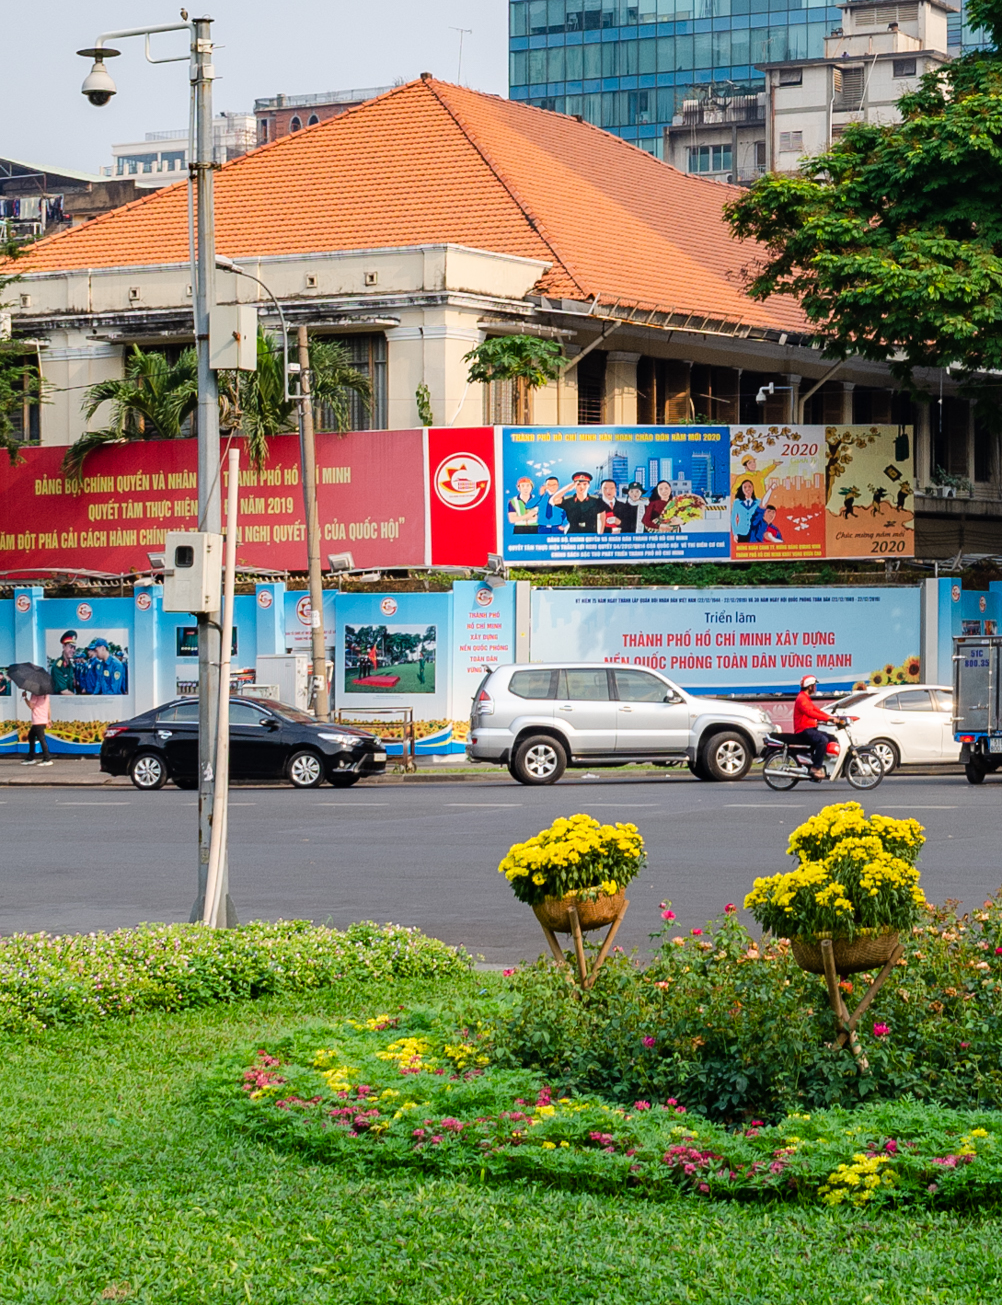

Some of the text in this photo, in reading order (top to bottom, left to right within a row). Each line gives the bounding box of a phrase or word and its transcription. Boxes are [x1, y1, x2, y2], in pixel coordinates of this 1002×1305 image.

[703, 433, 721, 442] 2020
[781, 444, 818, 456] 2020
[35, 474, 62, 495] ĐẢNG
[83, 473, 115, 493] CHÍNH
[117, 470, 150, 493] QUYỀN
[152, 471, 166, 491] VÀ
[168, 469, 197, 490] NHÂN
[261, 464, 281, 486] PHỐ
[284, 463, 298, 486] HỒ
[322, 467, 351, 484] MINH
[88, 498, 119, 522] QUYẾT
[121, 499, 143, 520] TÂM
[146, 500, 172, 521] THỰC
[174, 497, 198, 520] HIỆN
[240, 495, 265, 514] NĂM
[268, 497, 294, 514] 2019
[18, 530, 36, 553] ĐỘT
[38, 529, 58, 549] PHÁ
[61, 527, 78, 549] CẢI
[80, 528, 107, 548] CÁCH
[109, 527, 137, 547] HÀNH
[139, 528, 171, 546] CHÍN
[245, 525, 270, 545] NGHỊ
[273, 519, 306, 543] QUYẾT
[324, 519, 346, 540] CỦA
[349, 517, 378, 540] QUỐC
[870, 540, 906, 553] 2020
[704, 610, 756, 624] Triển lãm
[622, 628, 836, 648] THÀNH PHỐ HỒ CHÍ MINH XÂY DỰNG
[670, 652, 712, 670] PHÒNG
[716, 652, 748, 669] TOÀN
[752, 652, 777, 668] DÂN
[780, 651, 812, 668] VỮNG
[816, 654, 852, 670] MẠNH
[970, 650, 984, 658] 51C
[964, 659, 990, 668] 800.35
